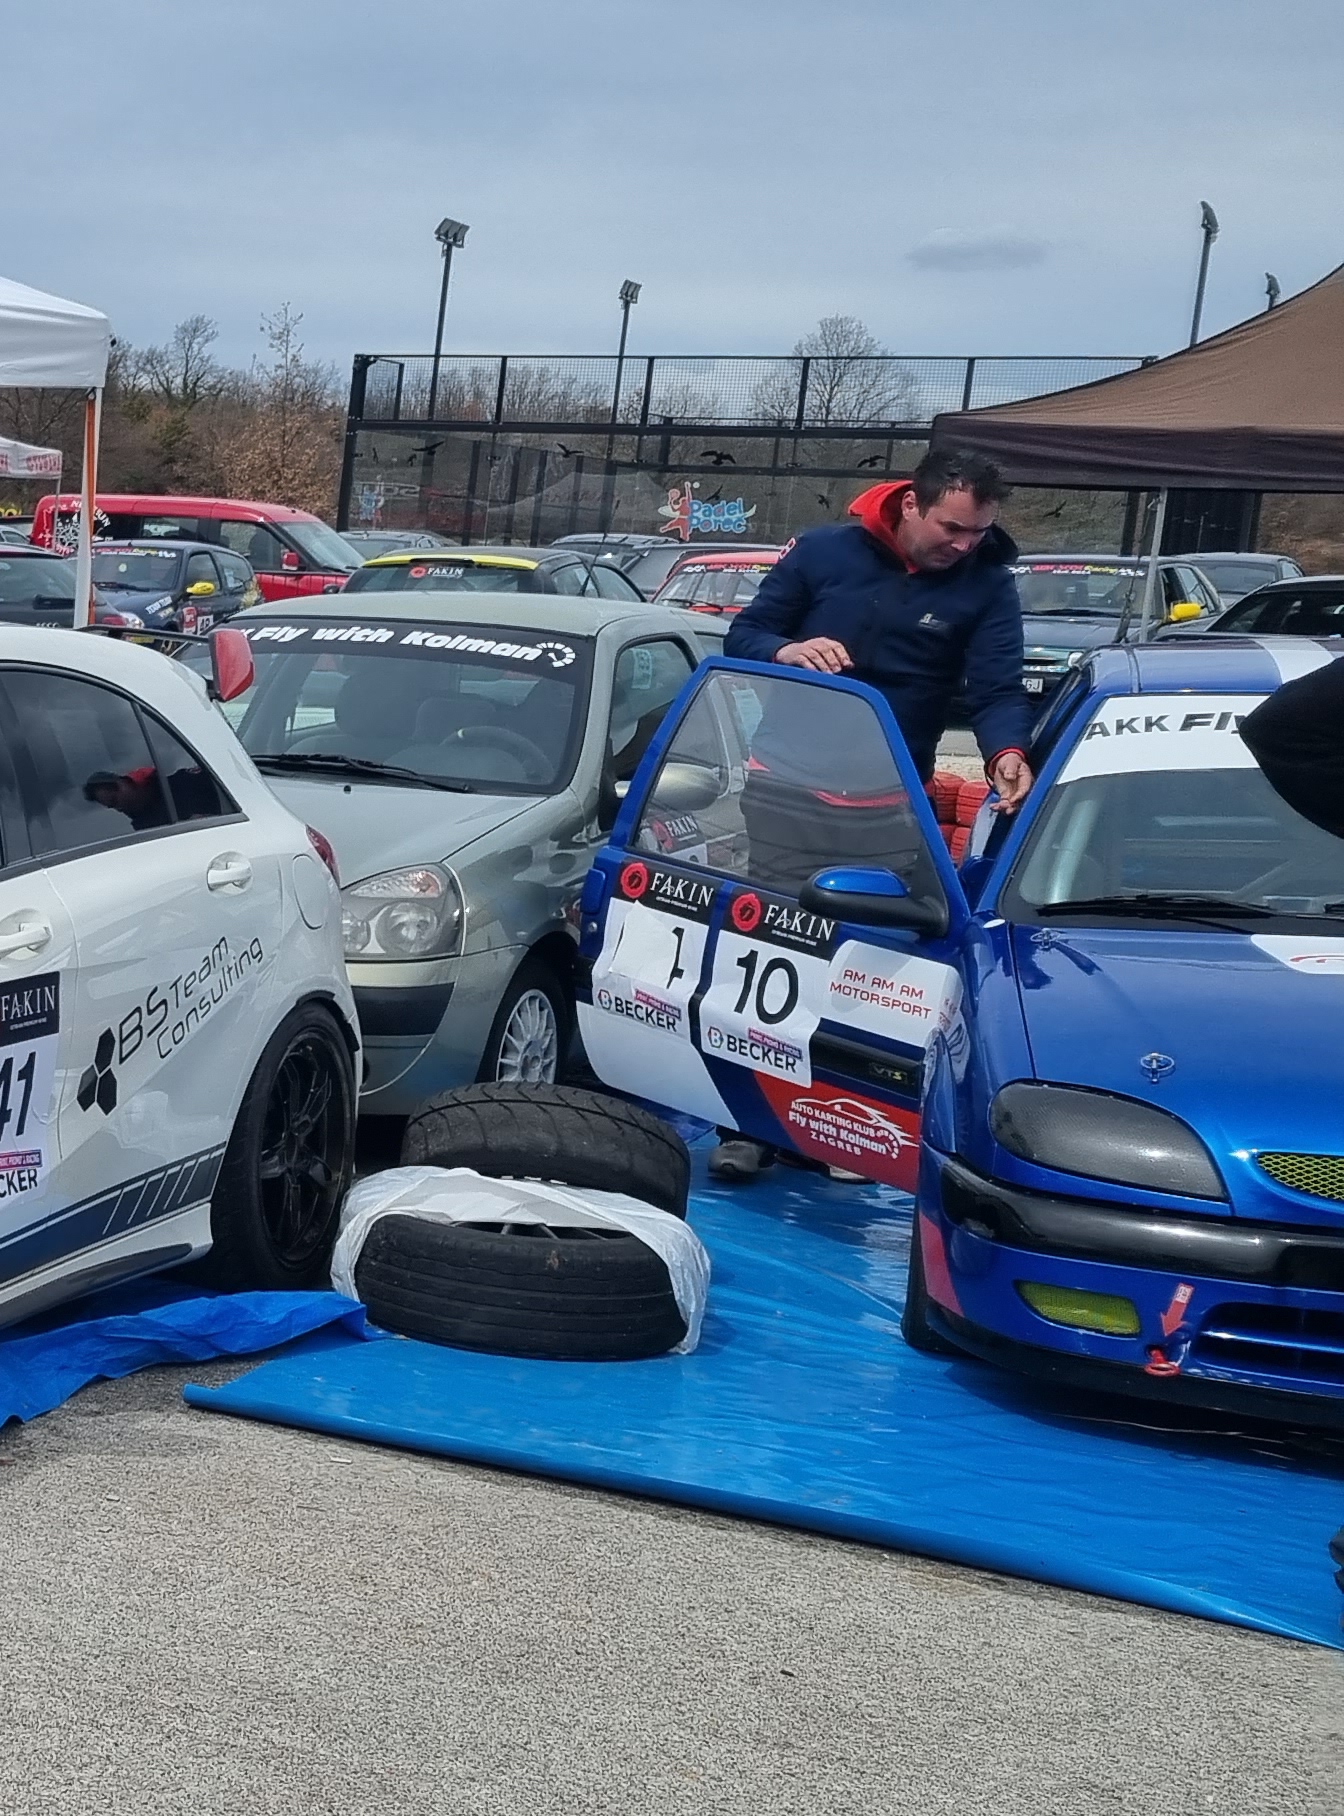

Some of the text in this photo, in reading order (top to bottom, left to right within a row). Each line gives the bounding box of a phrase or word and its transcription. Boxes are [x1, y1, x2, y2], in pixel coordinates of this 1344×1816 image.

[689, 497, 744, 519] Padel
[427, 567, 464, 576] FAKIN
[250, 626, 309, 643] Fly
[311, 625, 396, 643] with
[399, 630, 544, 662] Kolman
[1083, 713, 1171, 742] AKK
[664, 813, 699, 838] FAKIN
[650, 872, 714, 907] FAKIN
[764, 904, 836, 941] FAKIN
[157, 937, 263, 1059] Consulting
[733, 948, 800, 1025] 10
[829, 981, 932, 1019] MOTORSPORT
[843, 969, 924, 1000] AM AM AM
[1, 985, 56, 1022] FAKIN
[614, 995, 678, 1033] BECKER
[726, 1034, 797, 1074] BECKER
[873, 1065, 904, 1081] VTS
[788, 1111, 887, 1155] Fly with Kolman
[790, 1101, 876, 1138] AUTO KARTING KLUB
[810, 1131, 862, 1156] ZAGREB
